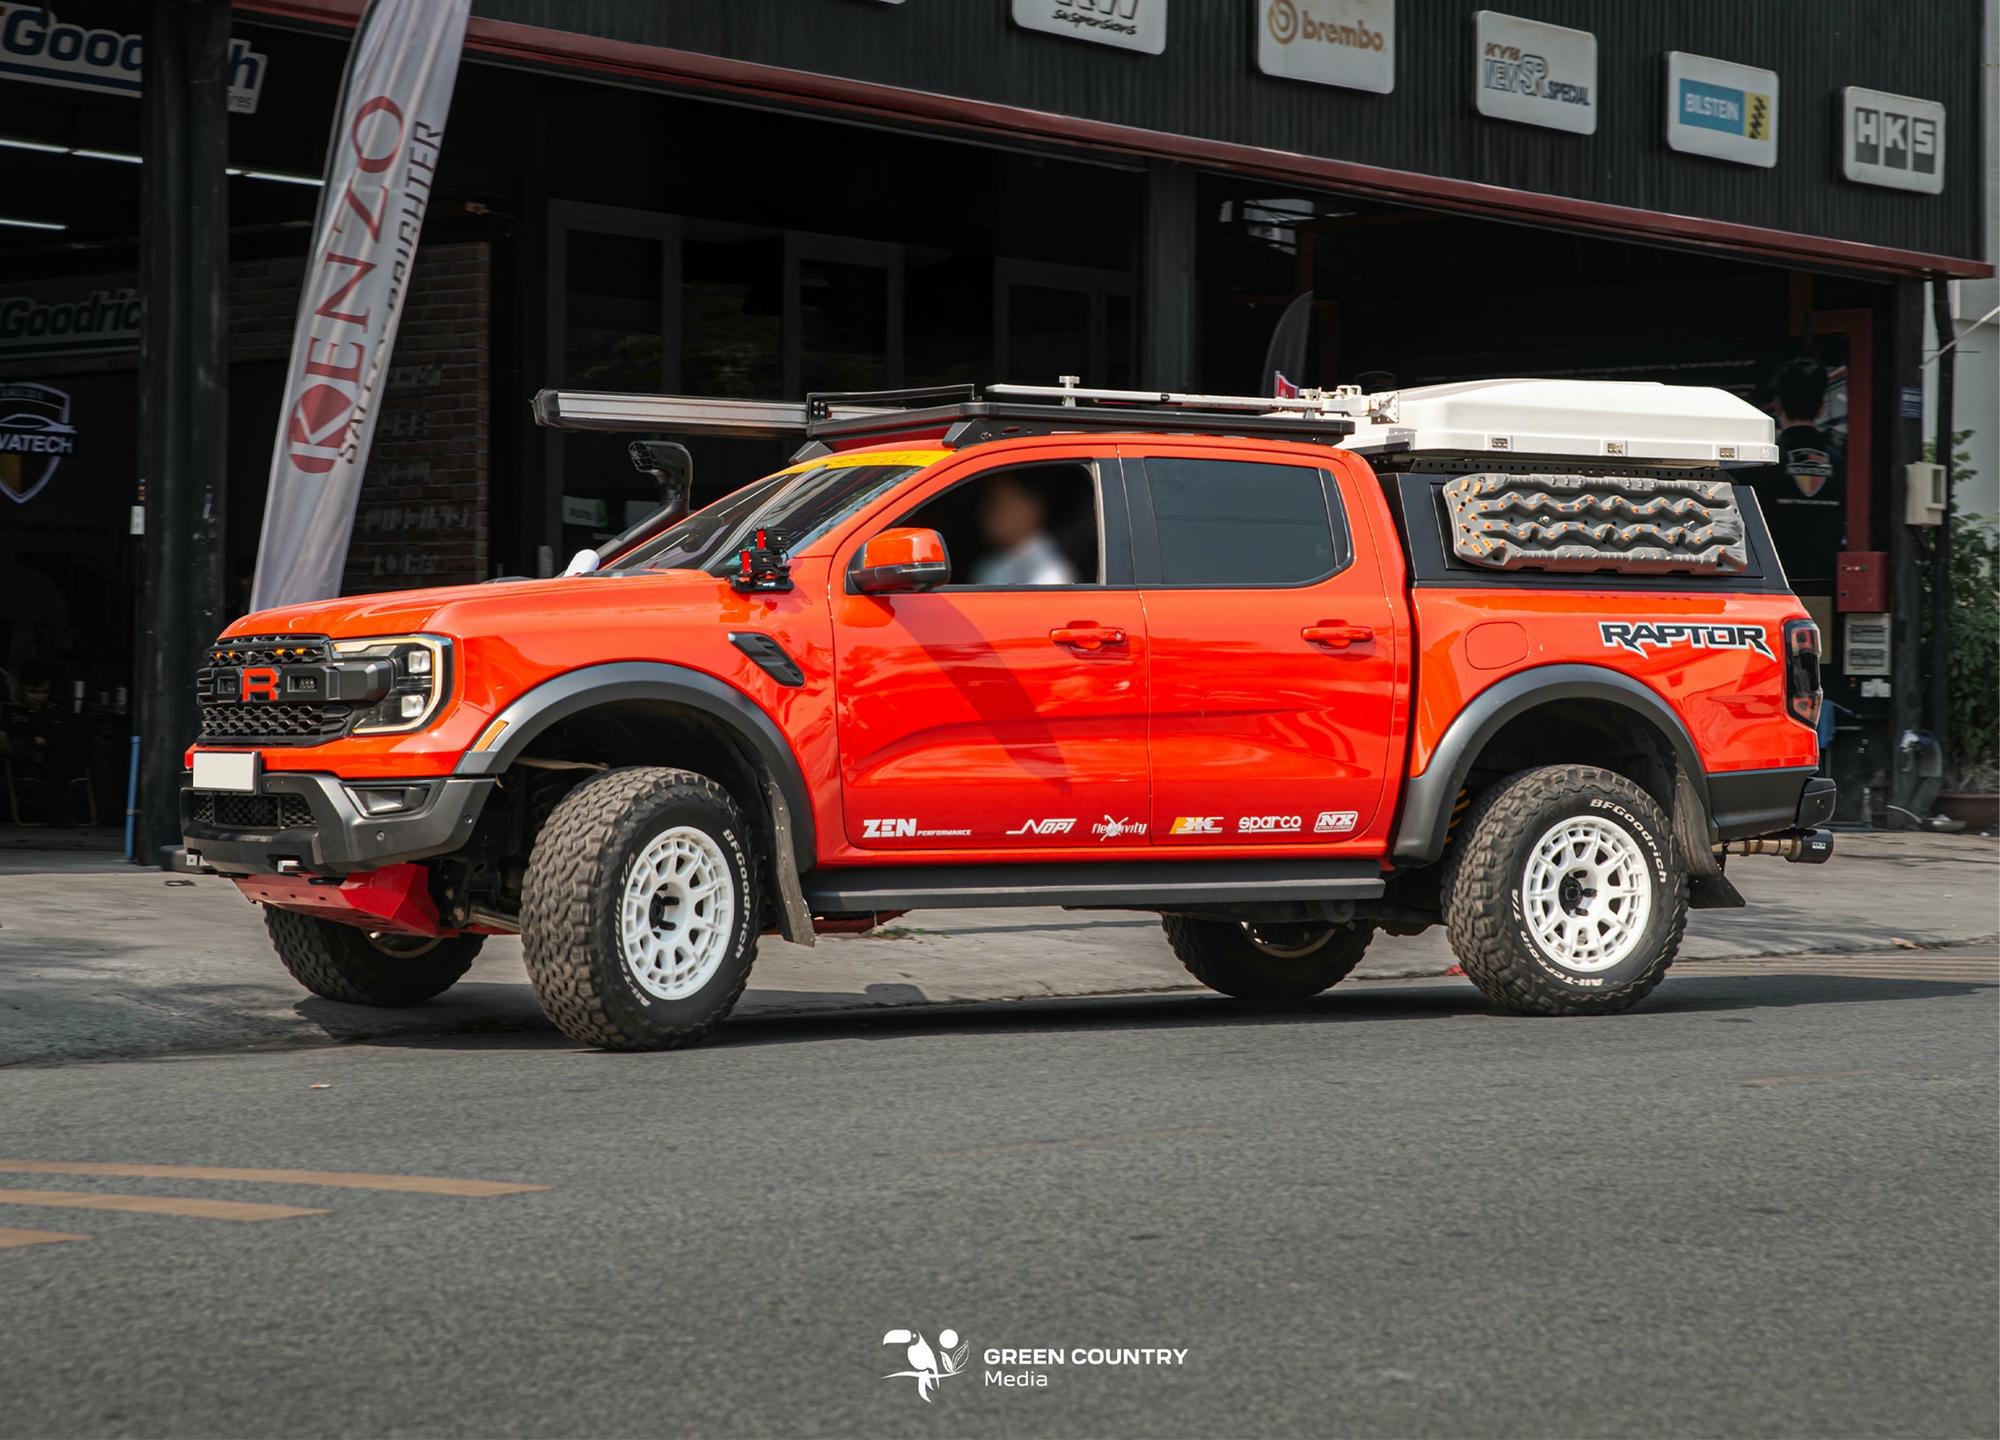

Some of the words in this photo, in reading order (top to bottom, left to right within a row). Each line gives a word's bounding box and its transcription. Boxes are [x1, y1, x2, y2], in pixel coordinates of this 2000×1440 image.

[1302, 10, 1384, 52] brembo
[1685, 93, 1739, 121] BILSTEIN
[1856, 109, 1936, 157] HKS
[287, 95, 404, 474] KENZO
[1598, 622, 1777, 662] RAPTOR
[862, 818, 917, 838] ZEN
[1005, 818, 1077, 835] NOPI
[1238, 815, 1302, 833] sparco
[1319, 814, 1355, 826] NX
[1590, 798, 1667, 883] BFGoodrich
[722, 829, 751, 959] BFGoodrich
